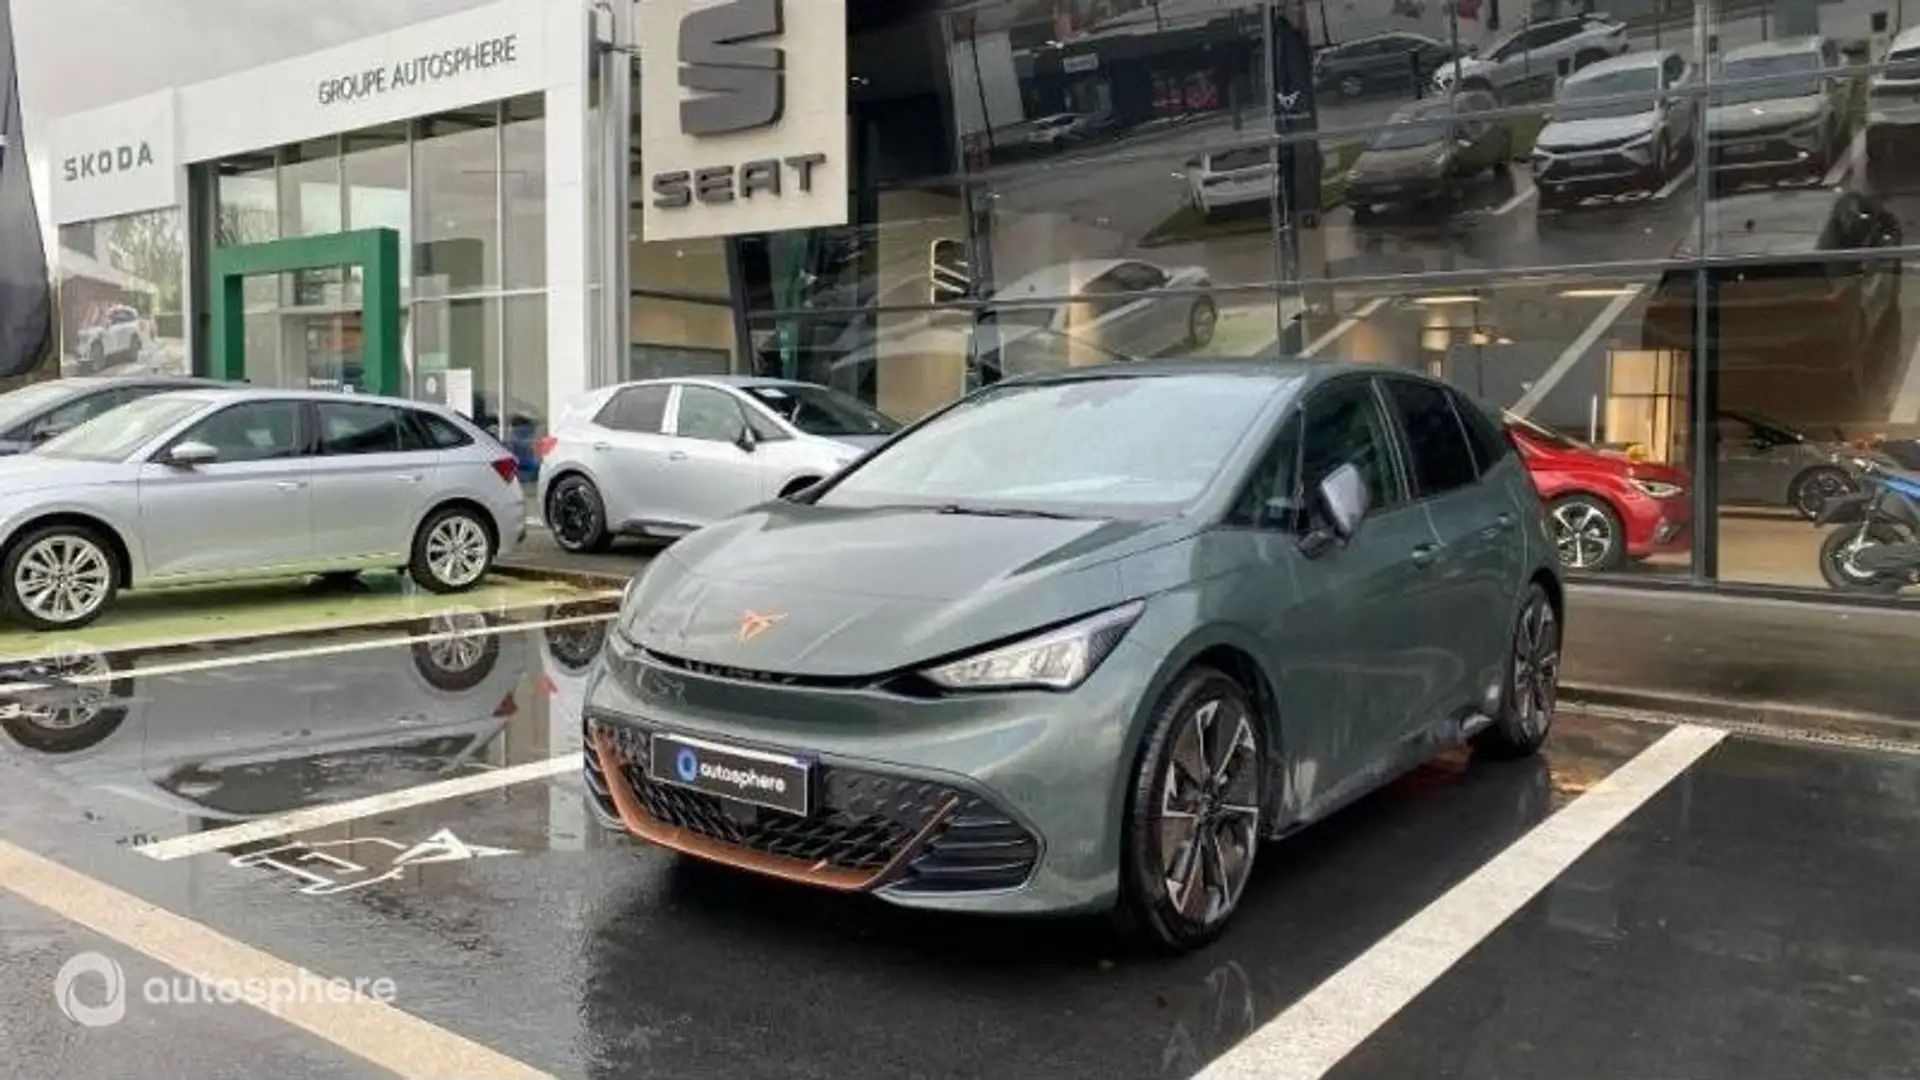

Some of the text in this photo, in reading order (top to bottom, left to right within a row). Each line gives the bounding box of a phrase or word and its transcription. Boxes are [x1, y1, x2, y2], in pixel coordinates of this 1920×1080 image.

[319, 34, 517, 104] GROUPE AUTOSPHERE
[64, 141, 154, 181] SKODA
[653, 152, 827, 209] SEAT
[700, 762, 786, 793] autosphere
